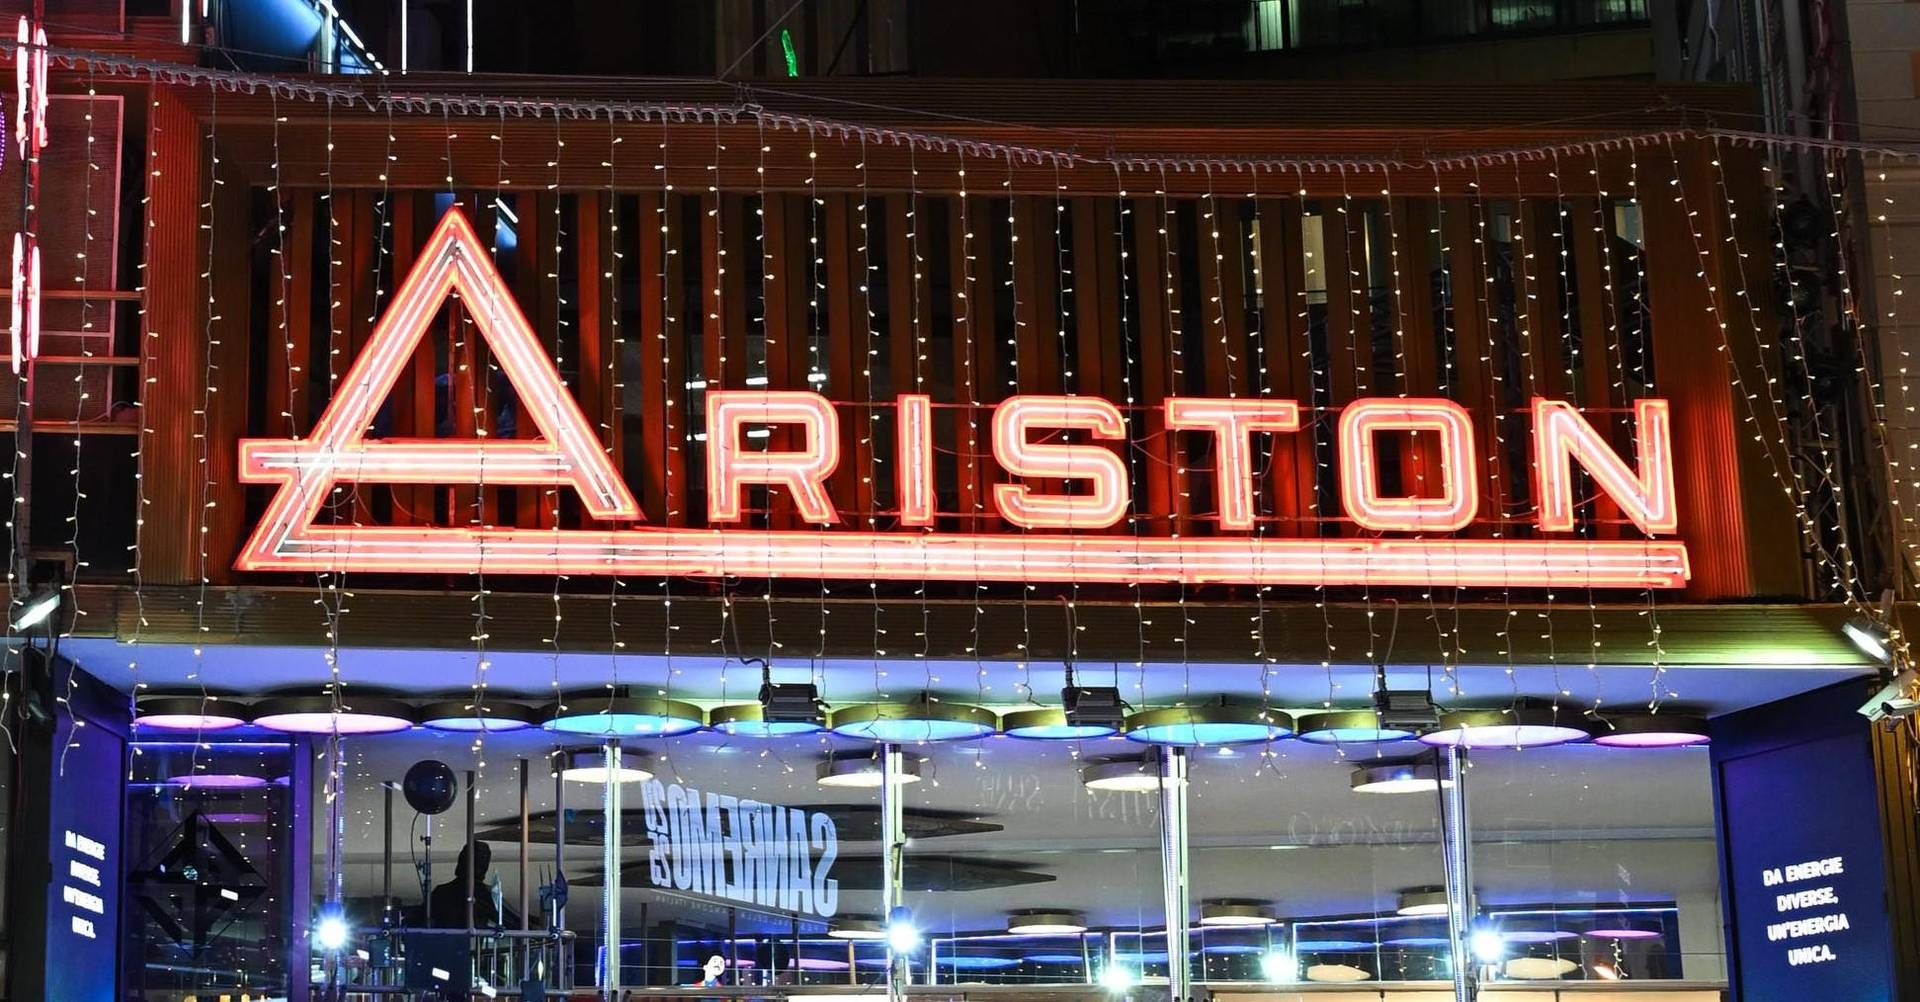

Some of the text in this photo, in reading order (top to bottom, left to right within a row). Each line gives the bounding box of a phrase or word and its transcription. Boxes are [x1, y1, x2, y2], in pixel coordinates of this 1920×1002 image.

[237, 206, 1686, 585] ARISTON
[1763, 857, 1843, 887] DA ENERGIE
[1767, 913, 1850, 941] UN'ENERGIA
[1788, 945, 1837, 966] UNICA.
